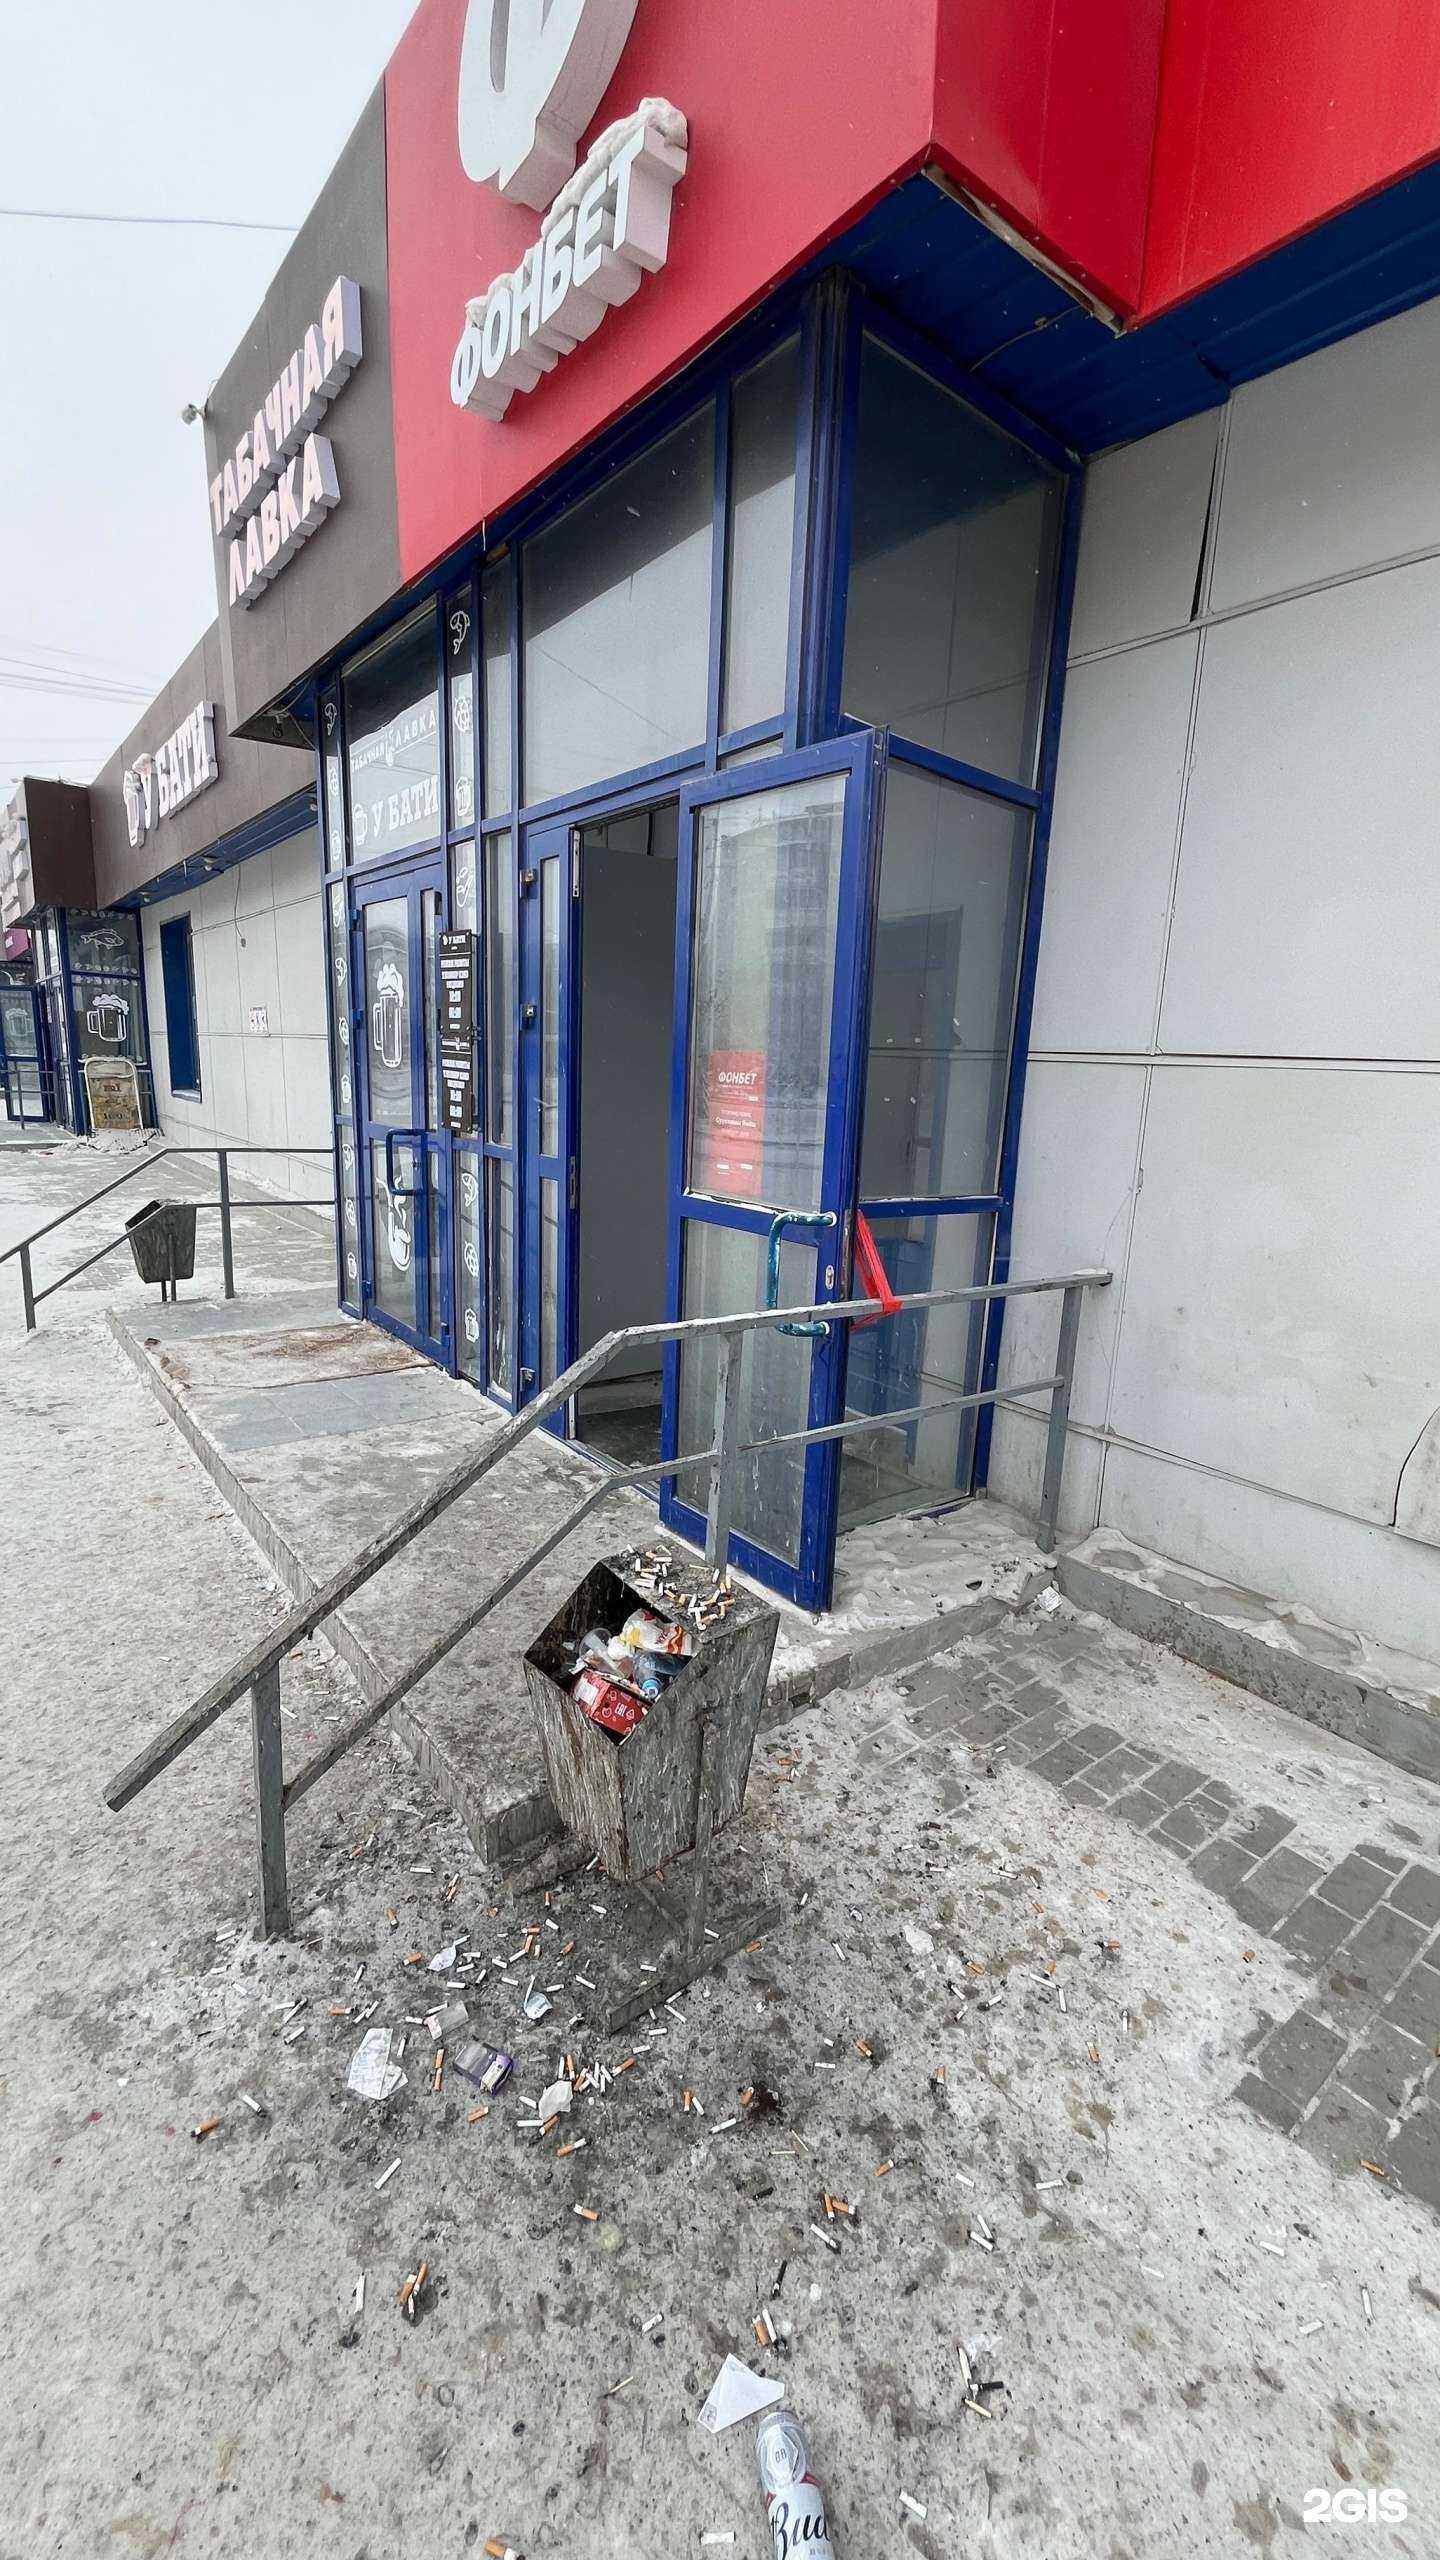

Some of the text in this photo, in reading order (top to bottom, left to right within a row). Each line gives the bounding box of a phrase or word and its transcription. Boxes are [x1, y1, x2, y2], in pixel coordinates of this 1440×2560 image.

[451, 126, 648, 408] ФОНБЕТ
[209, 275, 348, 536] ТАБАЧНАЯ
[229, 432, 331, 606] ЛАВКА
[154, 700, 210, 819] БАТИ
[396, 709, 437, 748] ЛАВКА
[372, 774, 439, 838] У БАТИ
[718, 1071, 758, 1085] ФОНБЕТ
